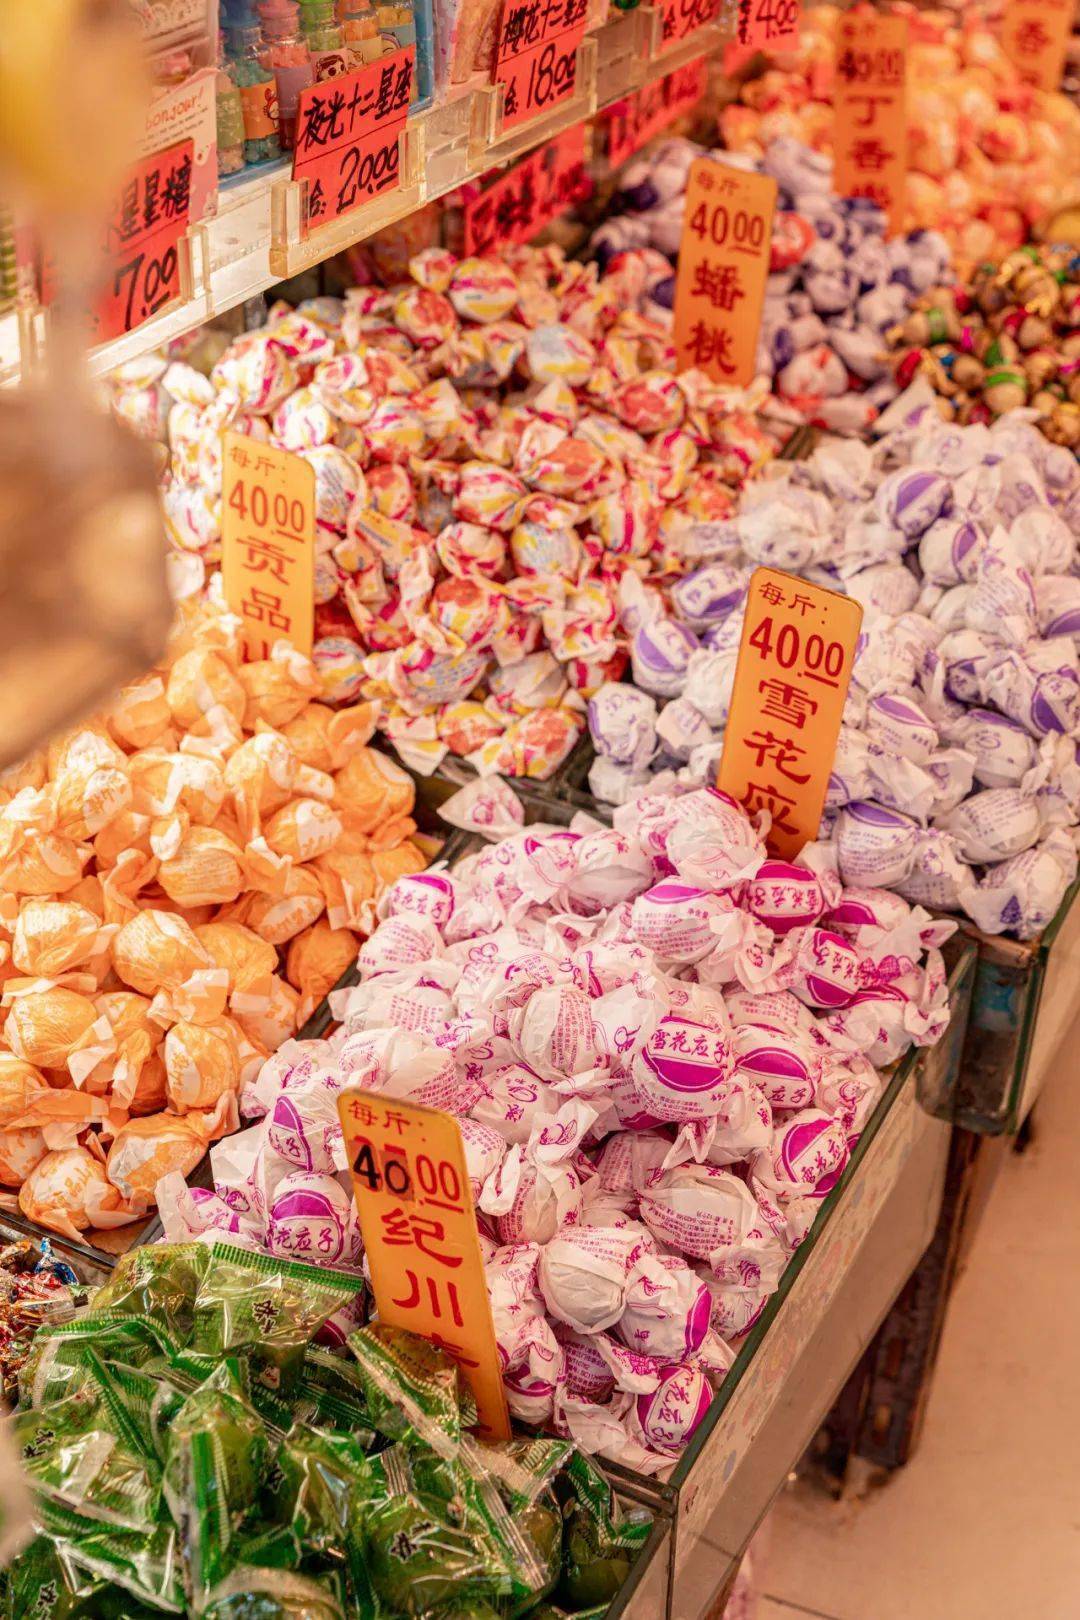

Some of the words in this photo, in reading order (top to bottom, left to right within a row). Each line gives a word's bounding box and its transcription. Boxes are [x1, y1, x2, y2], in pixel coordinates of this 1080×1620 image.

[298, 57, 413, 152] 夜光十二星座
[114, 246, 178, 332] 7.00
[685, 257, 745, 375] 蟠桃
[749, 616, 845, 689] 40.00
[738, 678, 819, 855] 雪花应
[651, 1028, 729, 1064] 雪花应子
[351, 1138, 466, 1215] 40.00
